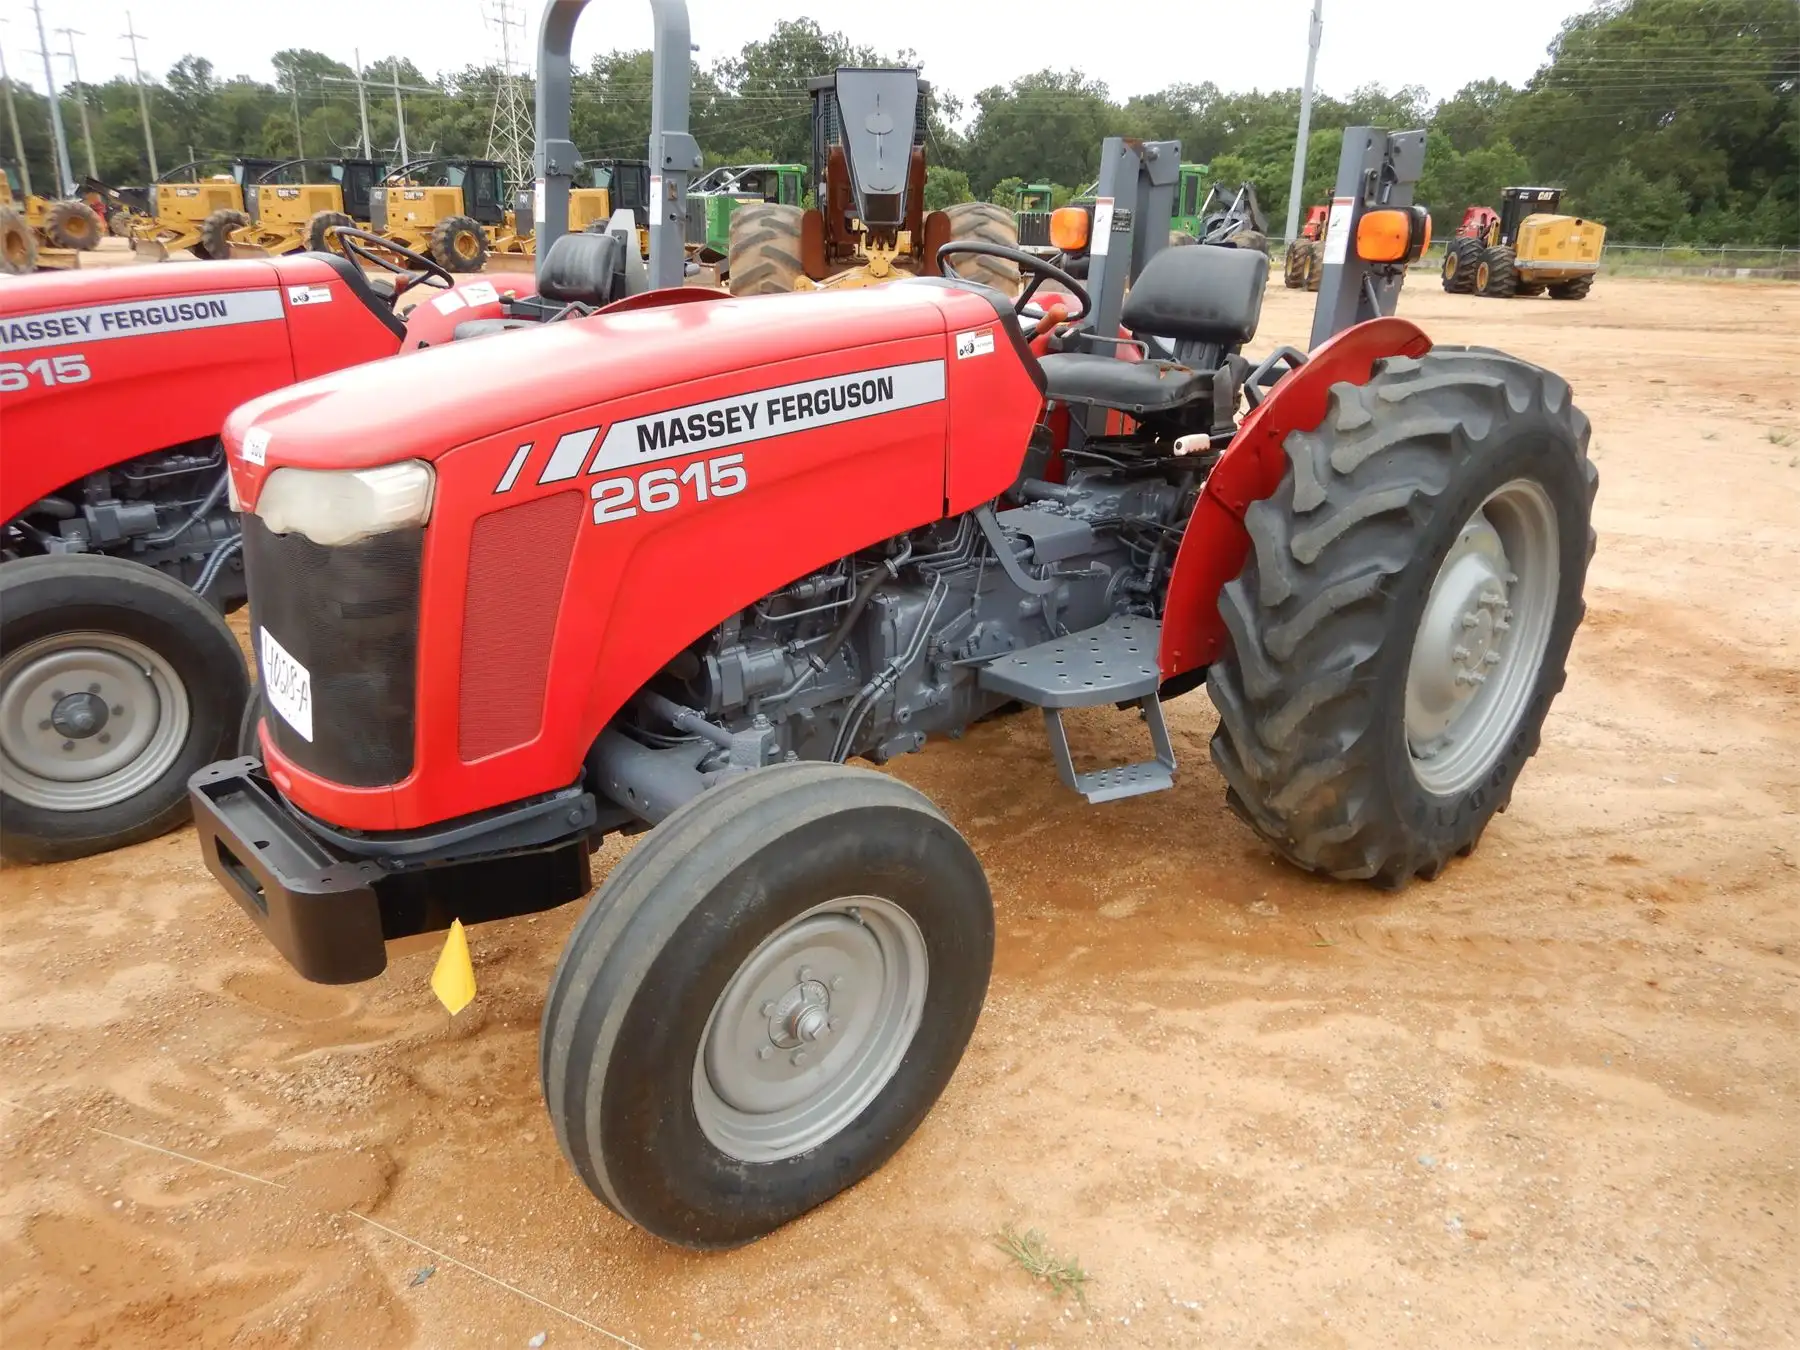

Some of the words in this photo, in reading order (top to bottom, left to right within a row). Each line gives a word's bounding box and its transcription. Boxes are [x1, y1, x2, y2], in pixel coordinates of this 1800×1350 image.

[1537, 191, 1554, 201] CAT
[100, 299, 228, 332] FERGUSON
[636, 402, 759, 453] MASSEY
[766, 375, 894, 426] FERGUSON
[590, 452, 748, 526] 2615
